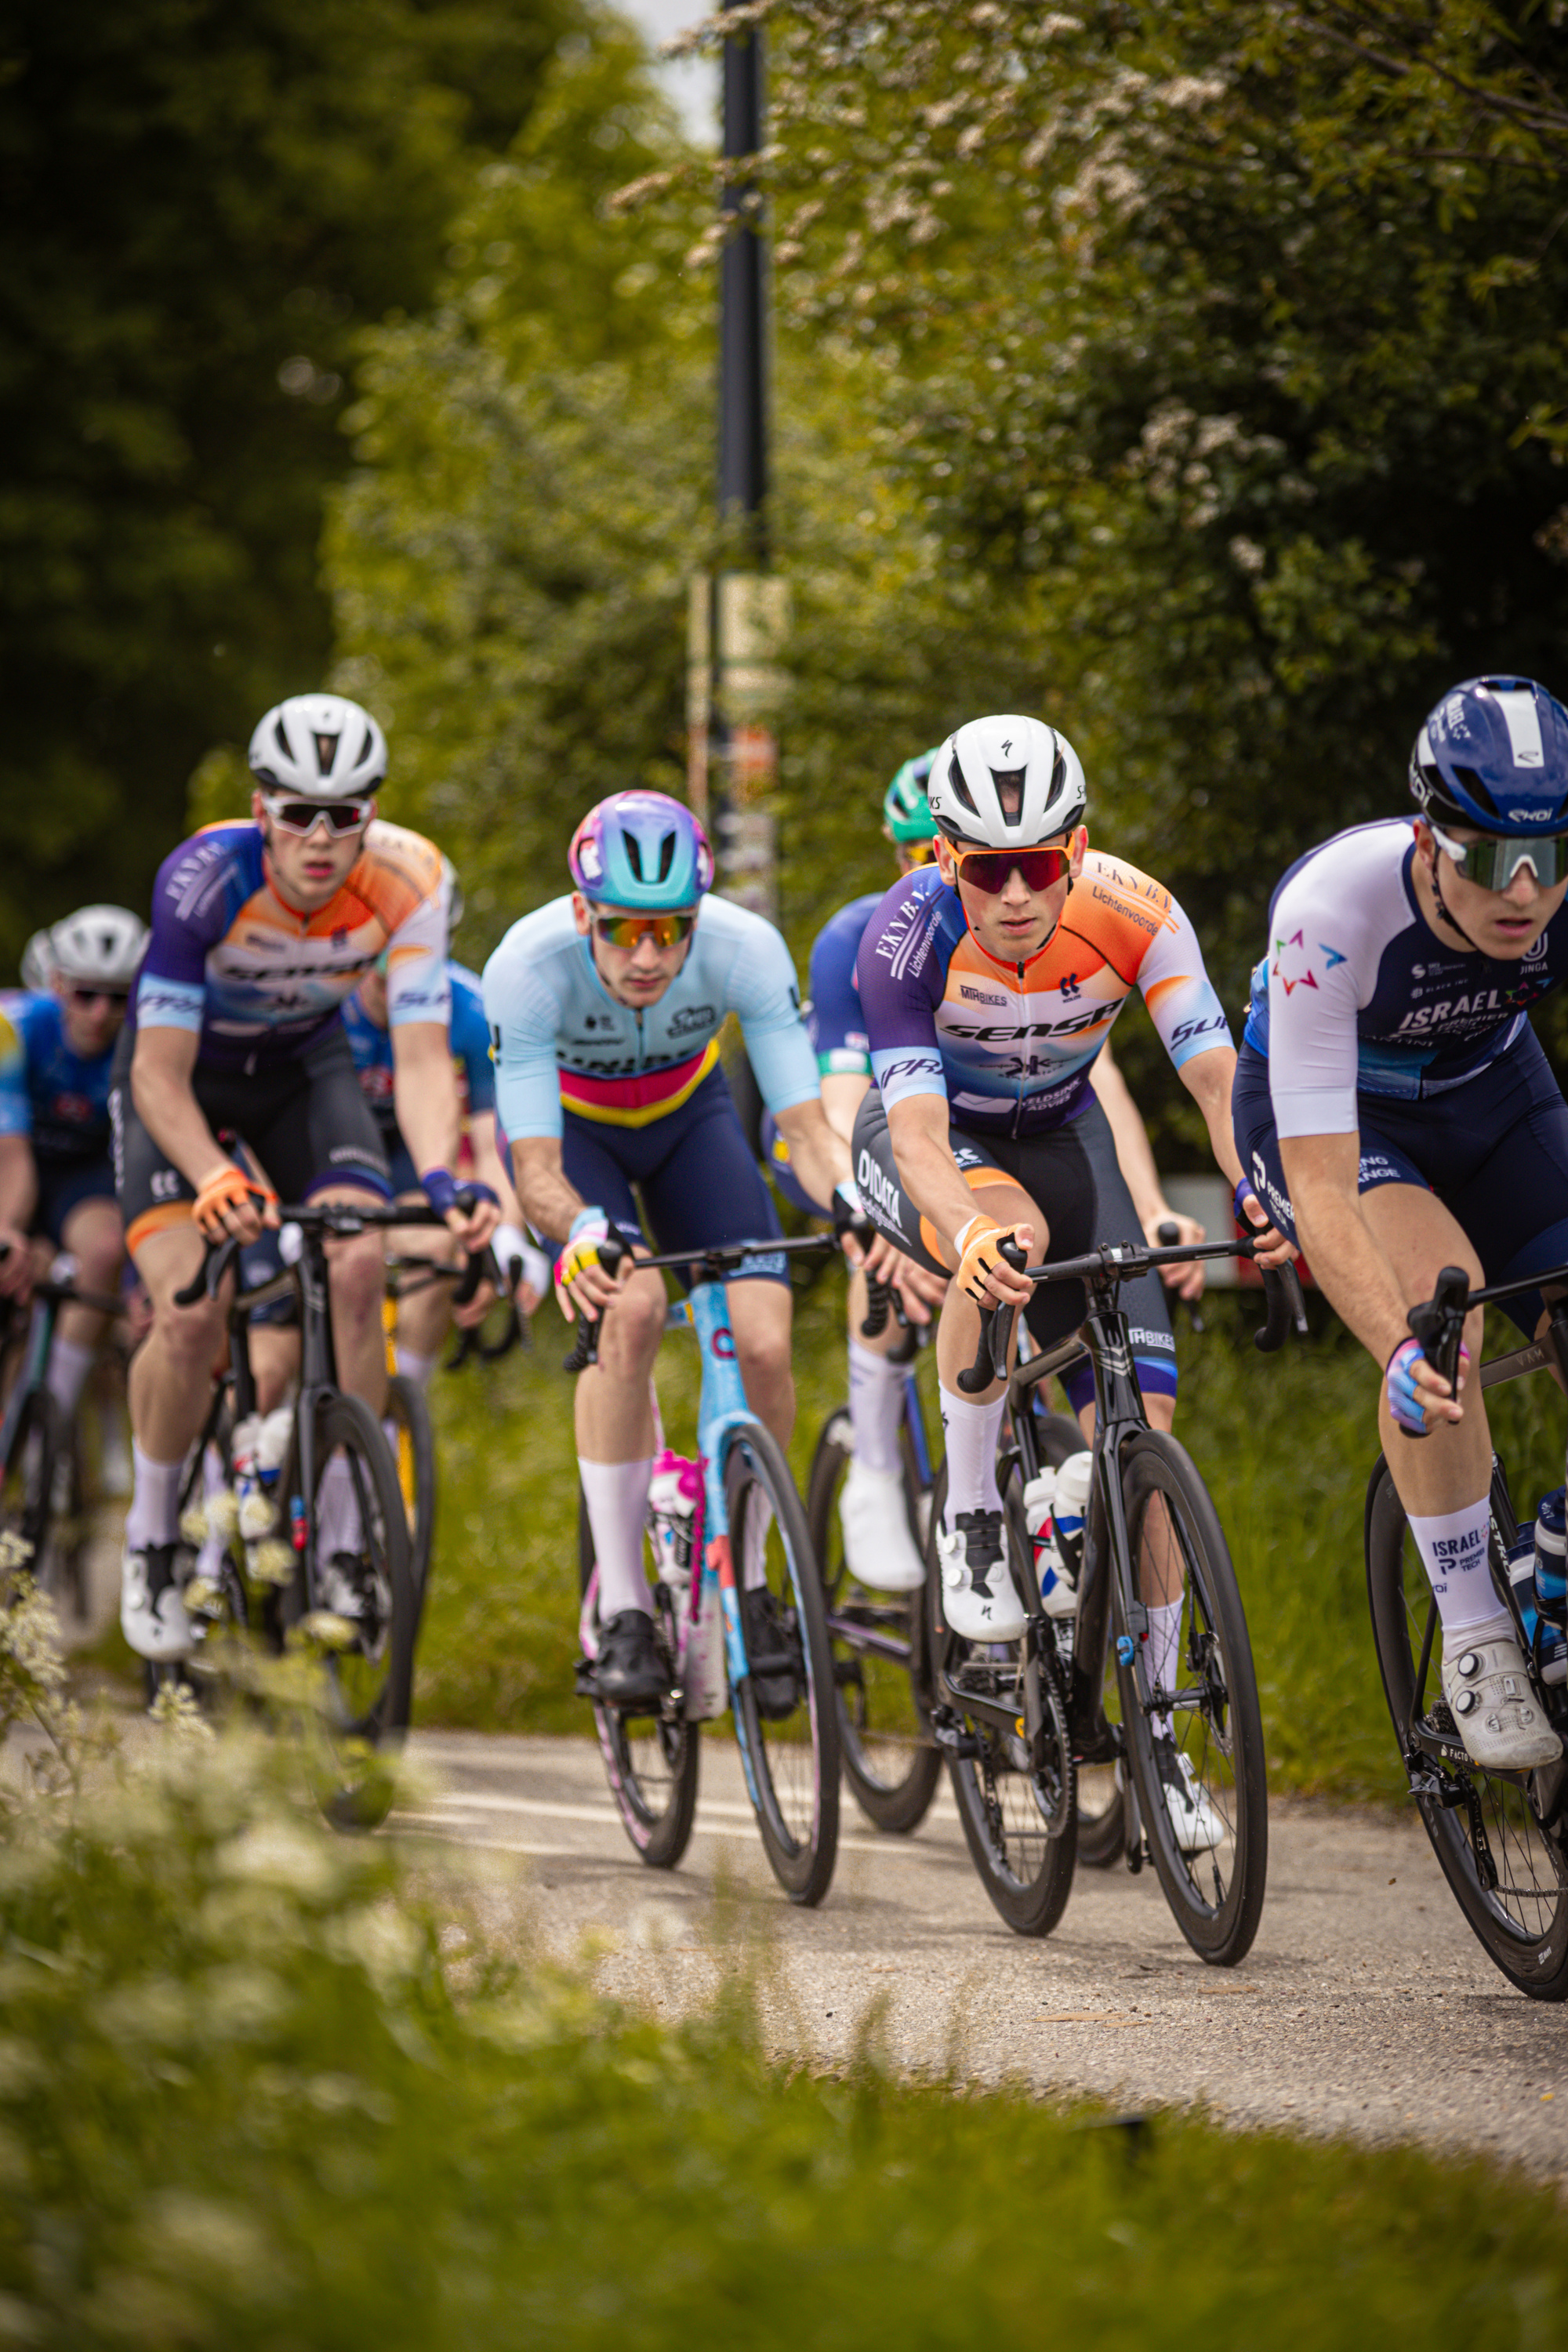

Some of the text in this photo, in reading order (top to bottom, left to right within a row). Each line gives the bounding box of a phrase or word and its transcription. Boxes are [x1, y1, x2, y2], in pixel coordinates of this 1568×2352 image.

[1092, 885, 1159, 937] Lichtenvoorde
[875, 915, 909, 960] EKN
[906, 910, 943, 978] Lichtenvoorde
[1519, 961, 1548, 975] JINGA
[1398, 989, 1502, 1030] ISRAEL
[1026, 1093, 1072, 1112] ADVIES
[857, 1148, 903, 1230] DIDATA
[1432, 1529, 1481, 1558] ISRAEL
[1459, 1547, 1486, 1566] PREMIER
[1461, 1559, 1481, 1573] TECH
